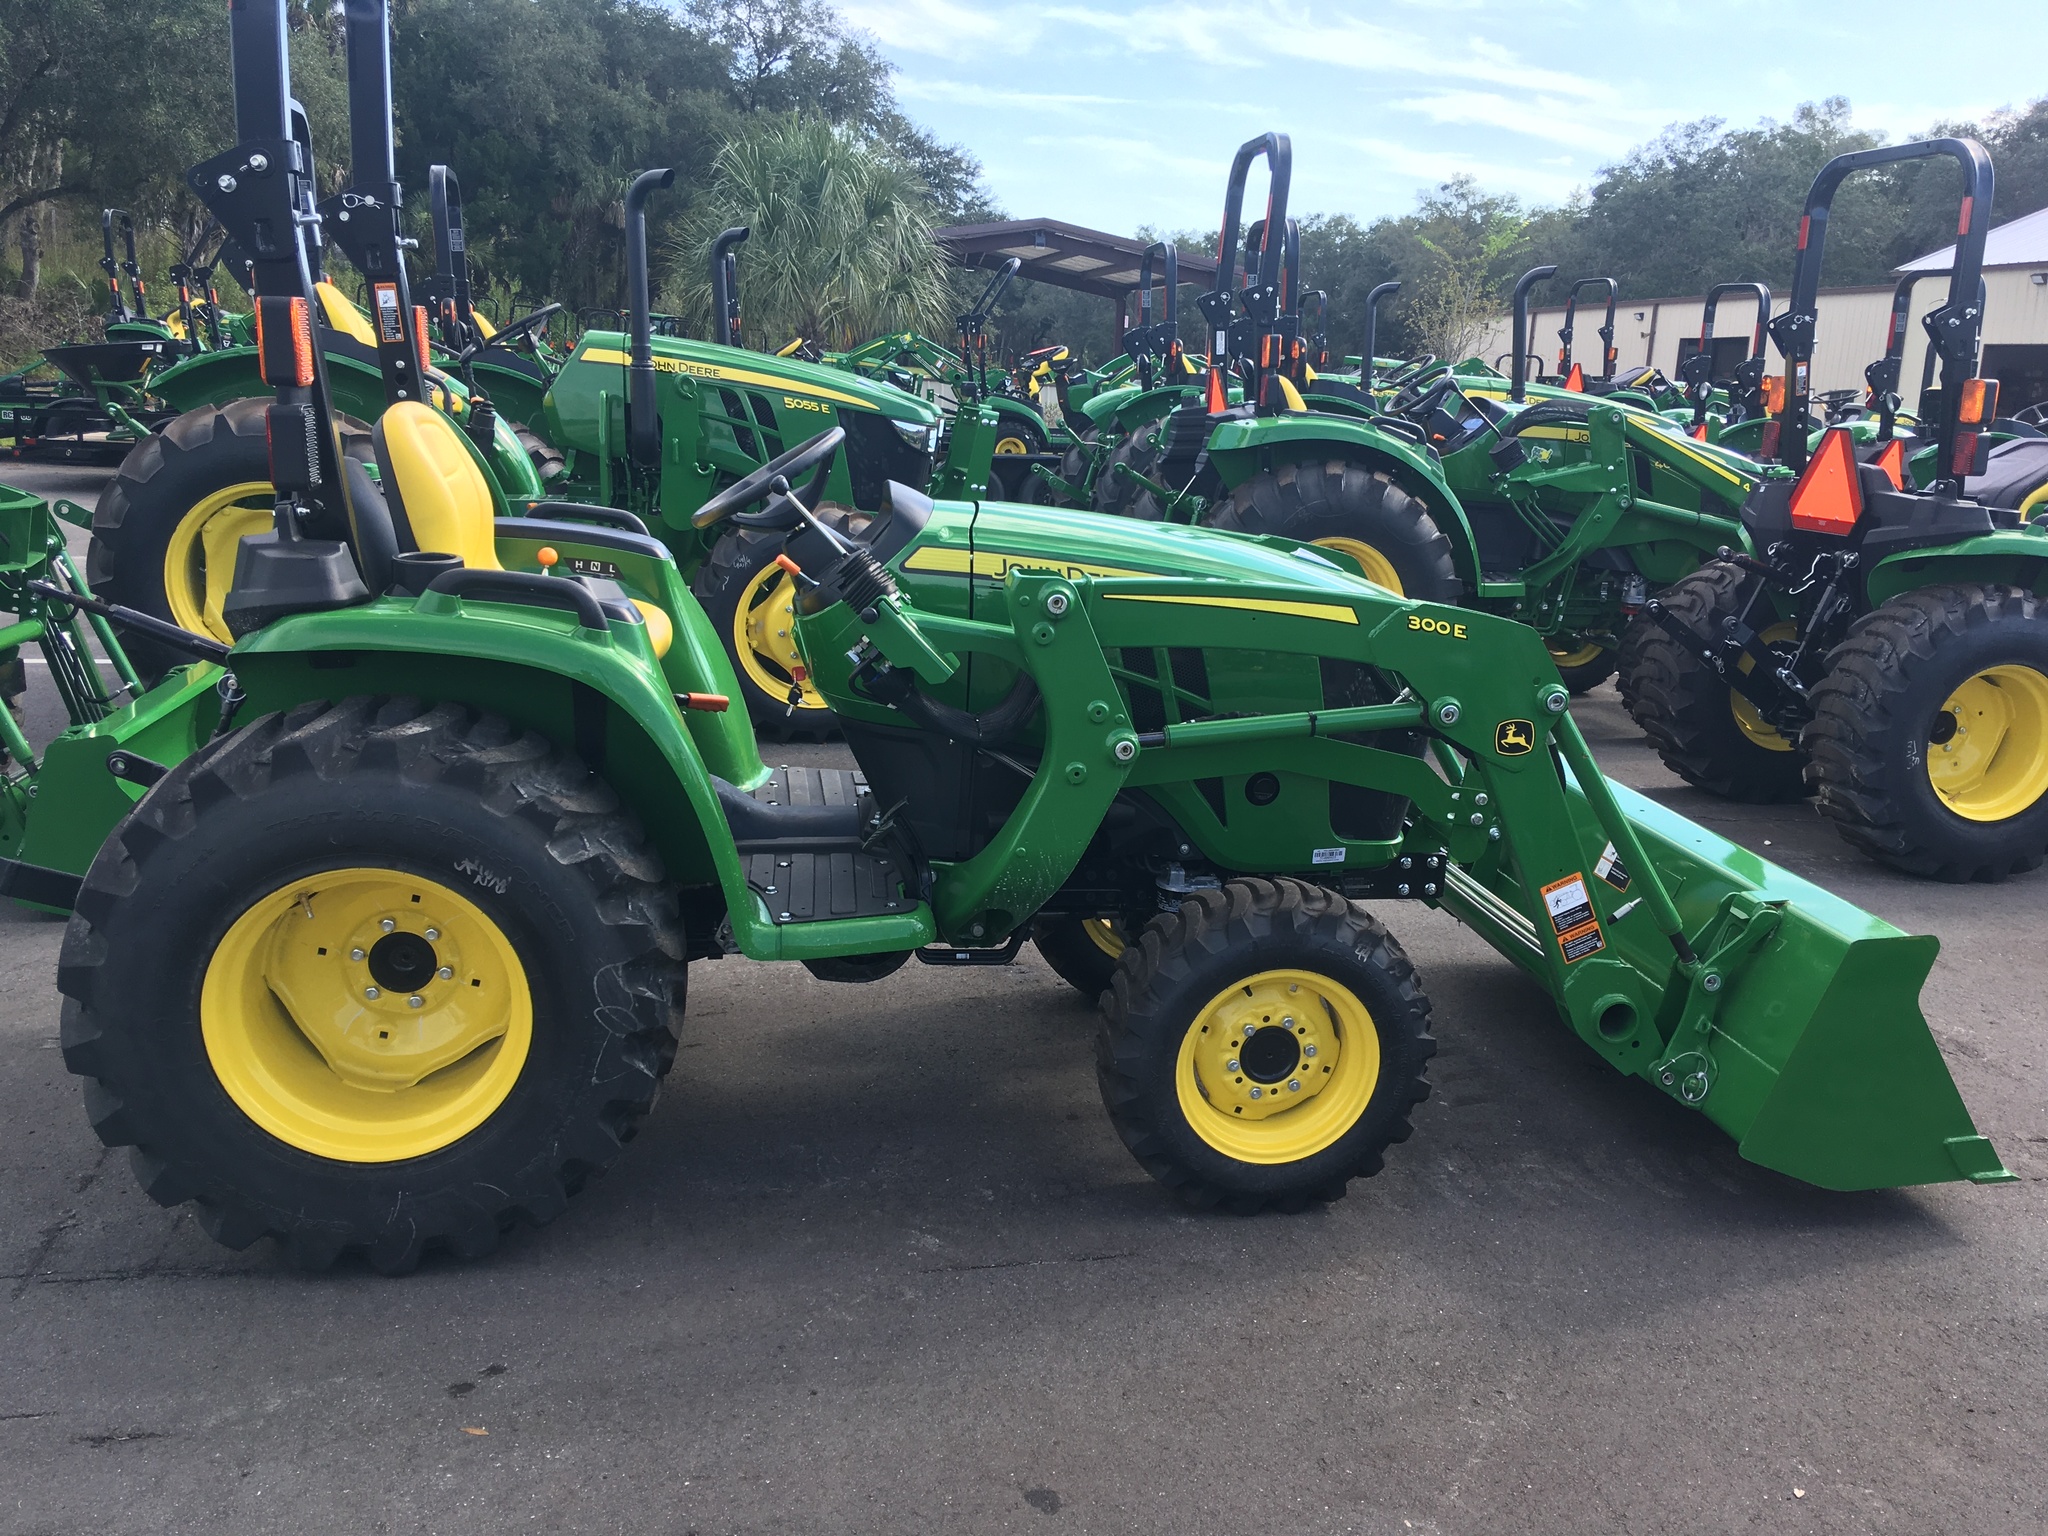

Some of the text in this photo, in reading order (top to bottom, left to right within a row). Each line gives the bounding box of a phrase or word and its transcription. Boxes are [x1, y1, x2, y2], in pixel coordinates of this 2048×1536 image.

[650, 360, 721, 378] OHN DEERE
[783, 396, 831, 414] 5055 E
[575, 560, 616, 573] H N L
[1408, 615, 1467, 639] 300 E
[1552, 875, 1578, 890] WARNING
[1570, 925, 1595, 939] WARNING
